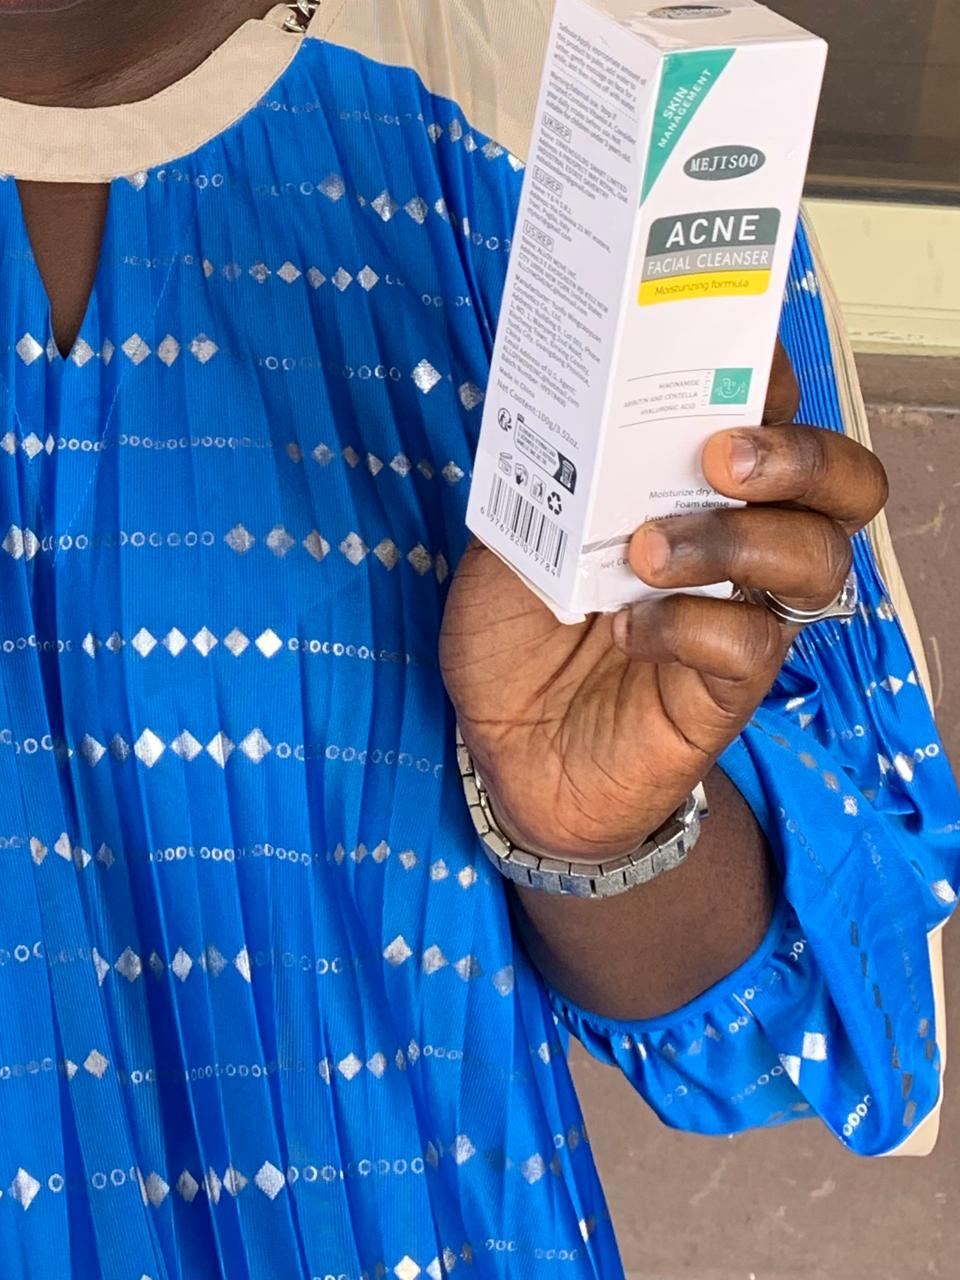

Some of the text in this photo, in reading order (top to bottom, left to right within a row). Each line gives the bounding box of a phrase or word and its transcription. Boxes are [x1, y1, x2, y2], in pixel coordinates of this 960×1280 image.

[657, 68, 712, 149] MANAGEMENT
[663, 86, 689, 120] SKIN
[690, 152, 759, 172] MEJISOO
[665, 215, 760, 248] ACNE
[647, 250, 769, 276] FACIAL CLEANSER
[654, 278, 749, 296] Moisturizing formula
[496, 377, 509, 394] Net
[648, 489, 694, 500] Moisturize
[696, 487, 711, 497] dry
[675, 500, 730, 508] Foam dense
